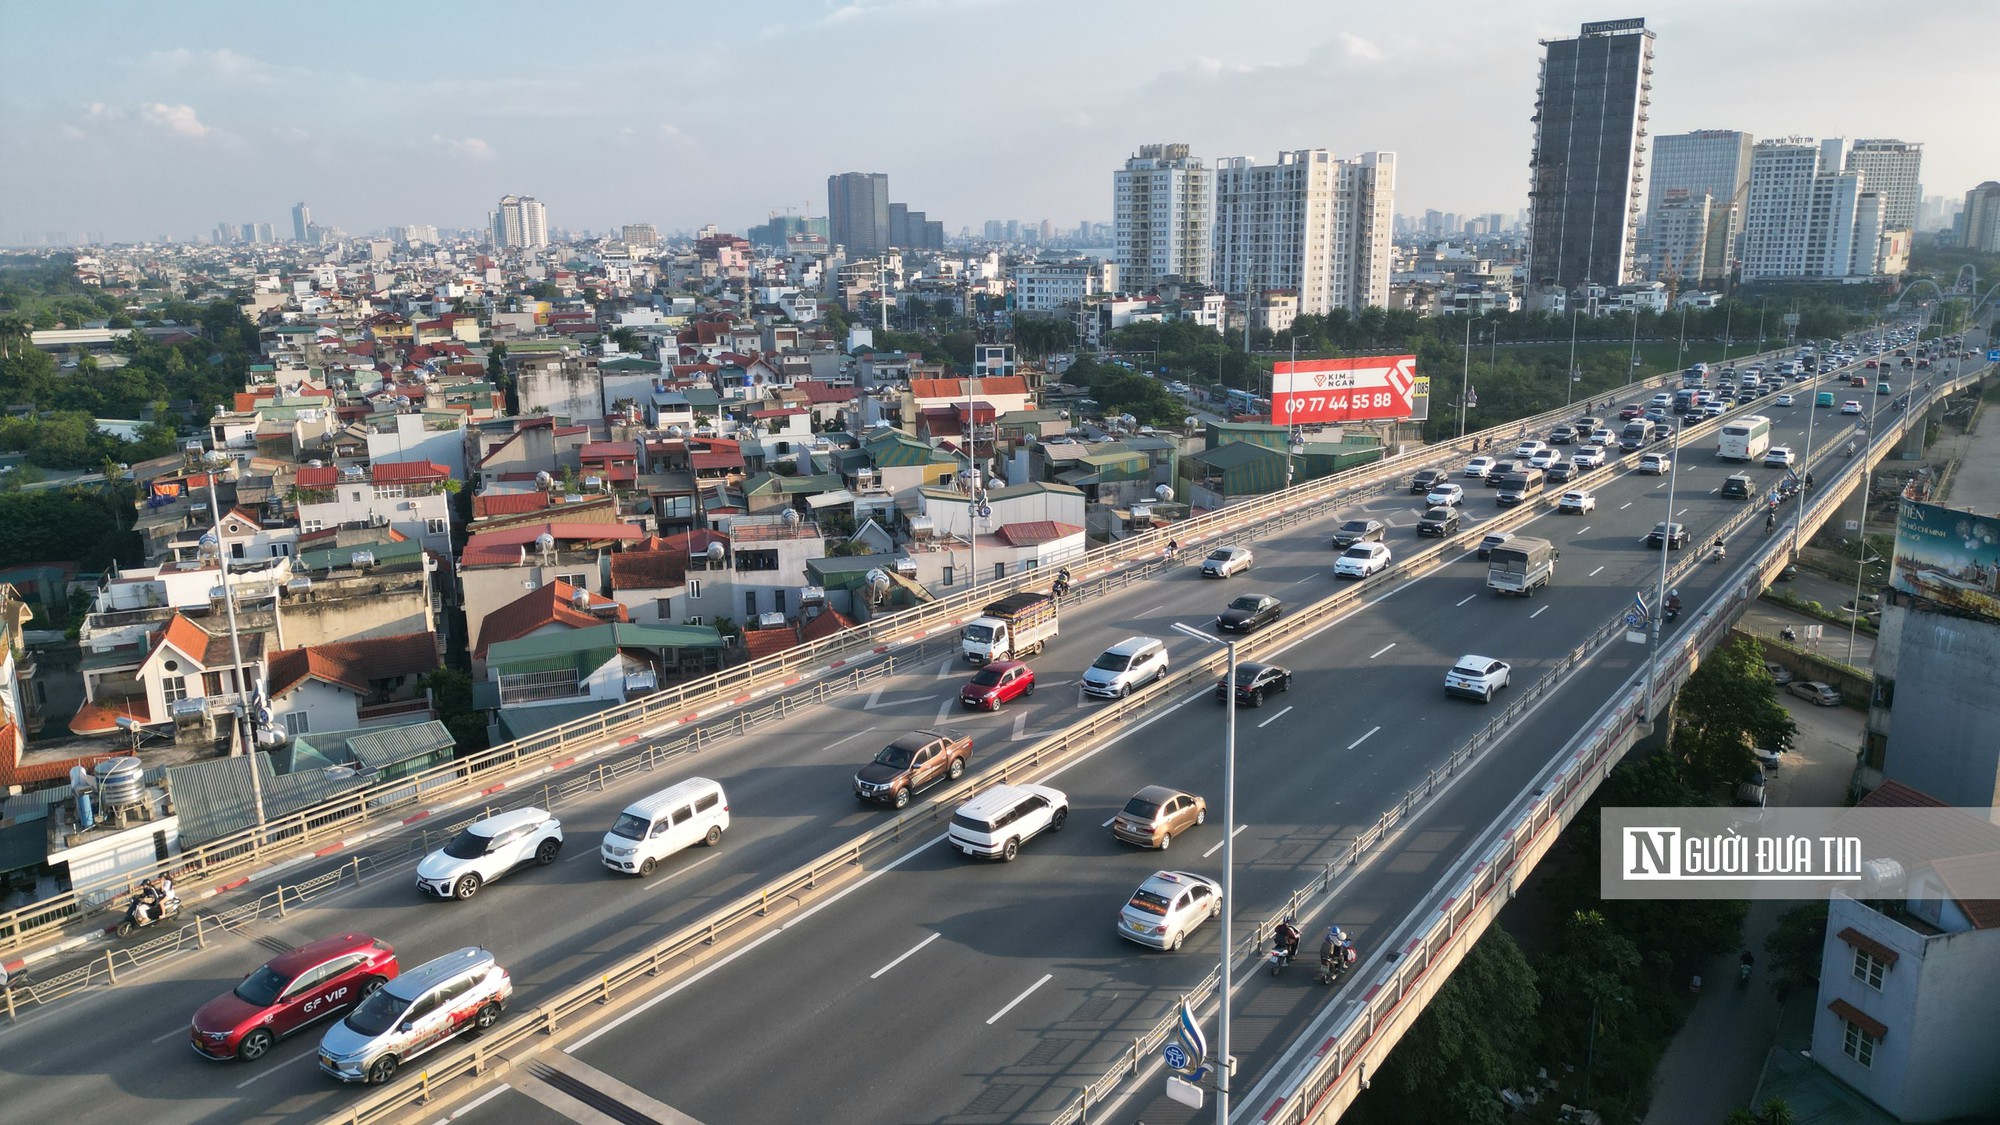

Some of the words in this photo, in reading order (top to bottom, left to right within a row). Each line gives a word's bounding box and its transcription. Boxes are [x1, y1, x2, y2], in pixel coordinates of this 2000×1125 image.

[1583, 20, 1642, 32] PentStudio
[1328, 379, 1355, 387] NGAN
[1414, 382, 1428, 395] 1085
[1285, 398, 1306, 414] 09
[1309, 397, 1326, 412] 77
[1328, 395, 1349, 411] 44
[1352, 394, 1370, 409] 55
[1373, 392, 1392, 408] 88
[304, 997, 322, 1013] GF
[325, 986, 348, 1003] VIP
